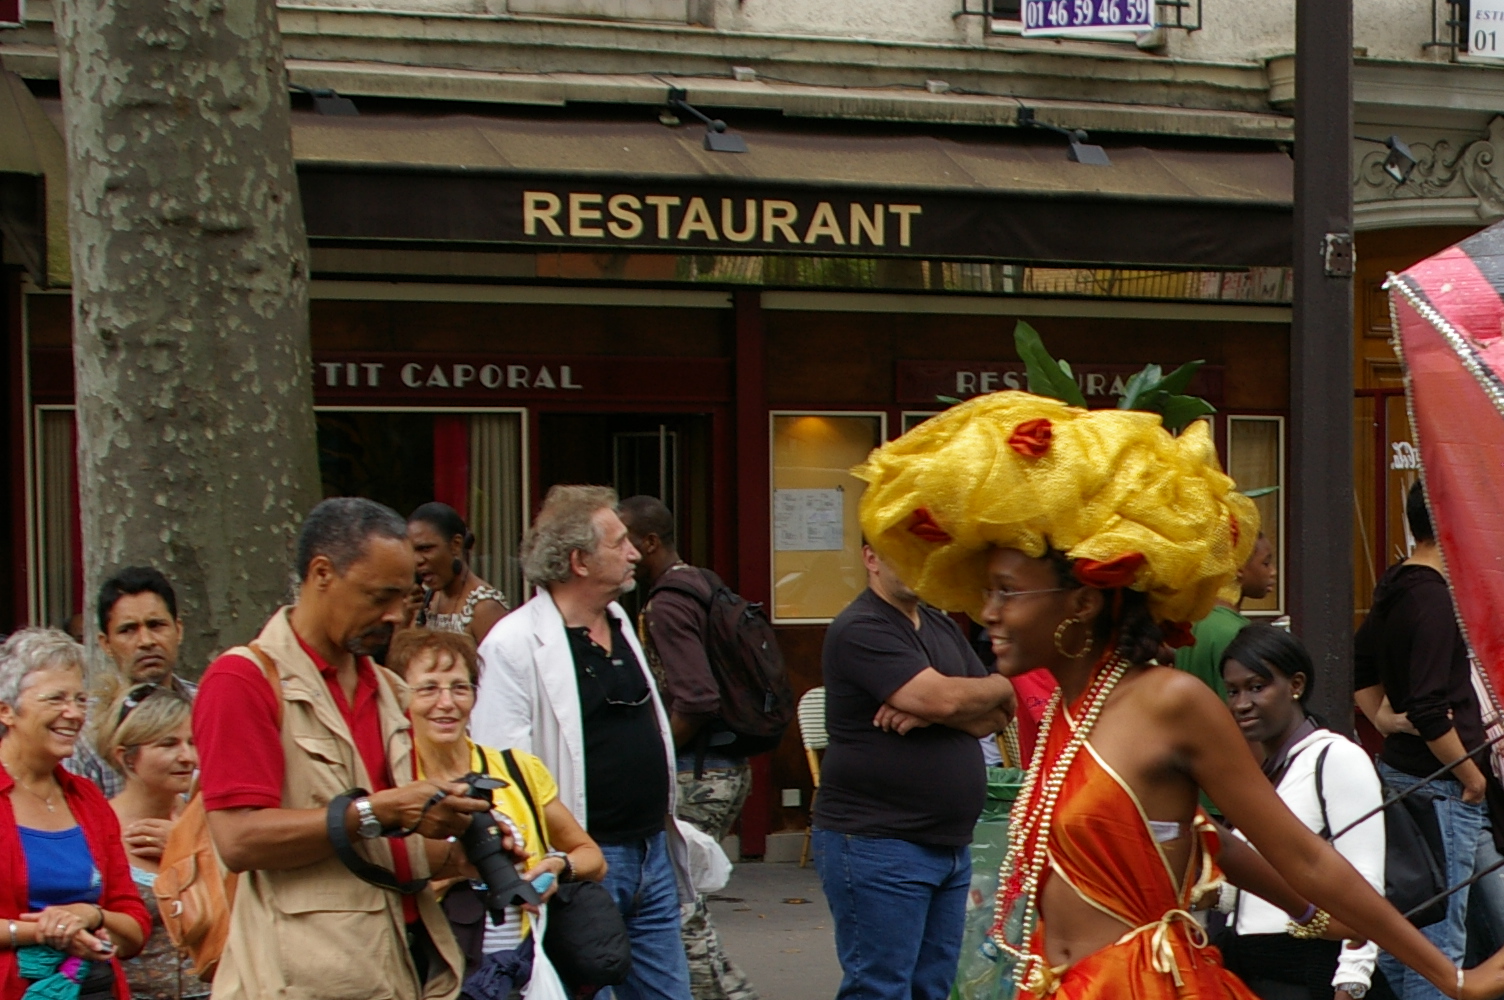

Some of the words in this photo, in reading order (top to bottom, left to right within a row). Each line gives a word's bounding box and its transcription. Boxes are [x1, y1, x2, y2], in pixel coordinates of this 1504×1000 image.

[1027, 1, 1044, 27] 01
[1047, 0, 1068, 26] 46
[1073, 0, 1094, 25] 59
[1098, 0, 1121, 24] 46
[1125, 0, 1147, 24] 59
[1474, 29, 1496, 51] 01
[523, 190, 922, 247] RESTAURANT
[311, 362, 384, 387] TIT
[401, 362, 583, 389] CAPORAL
